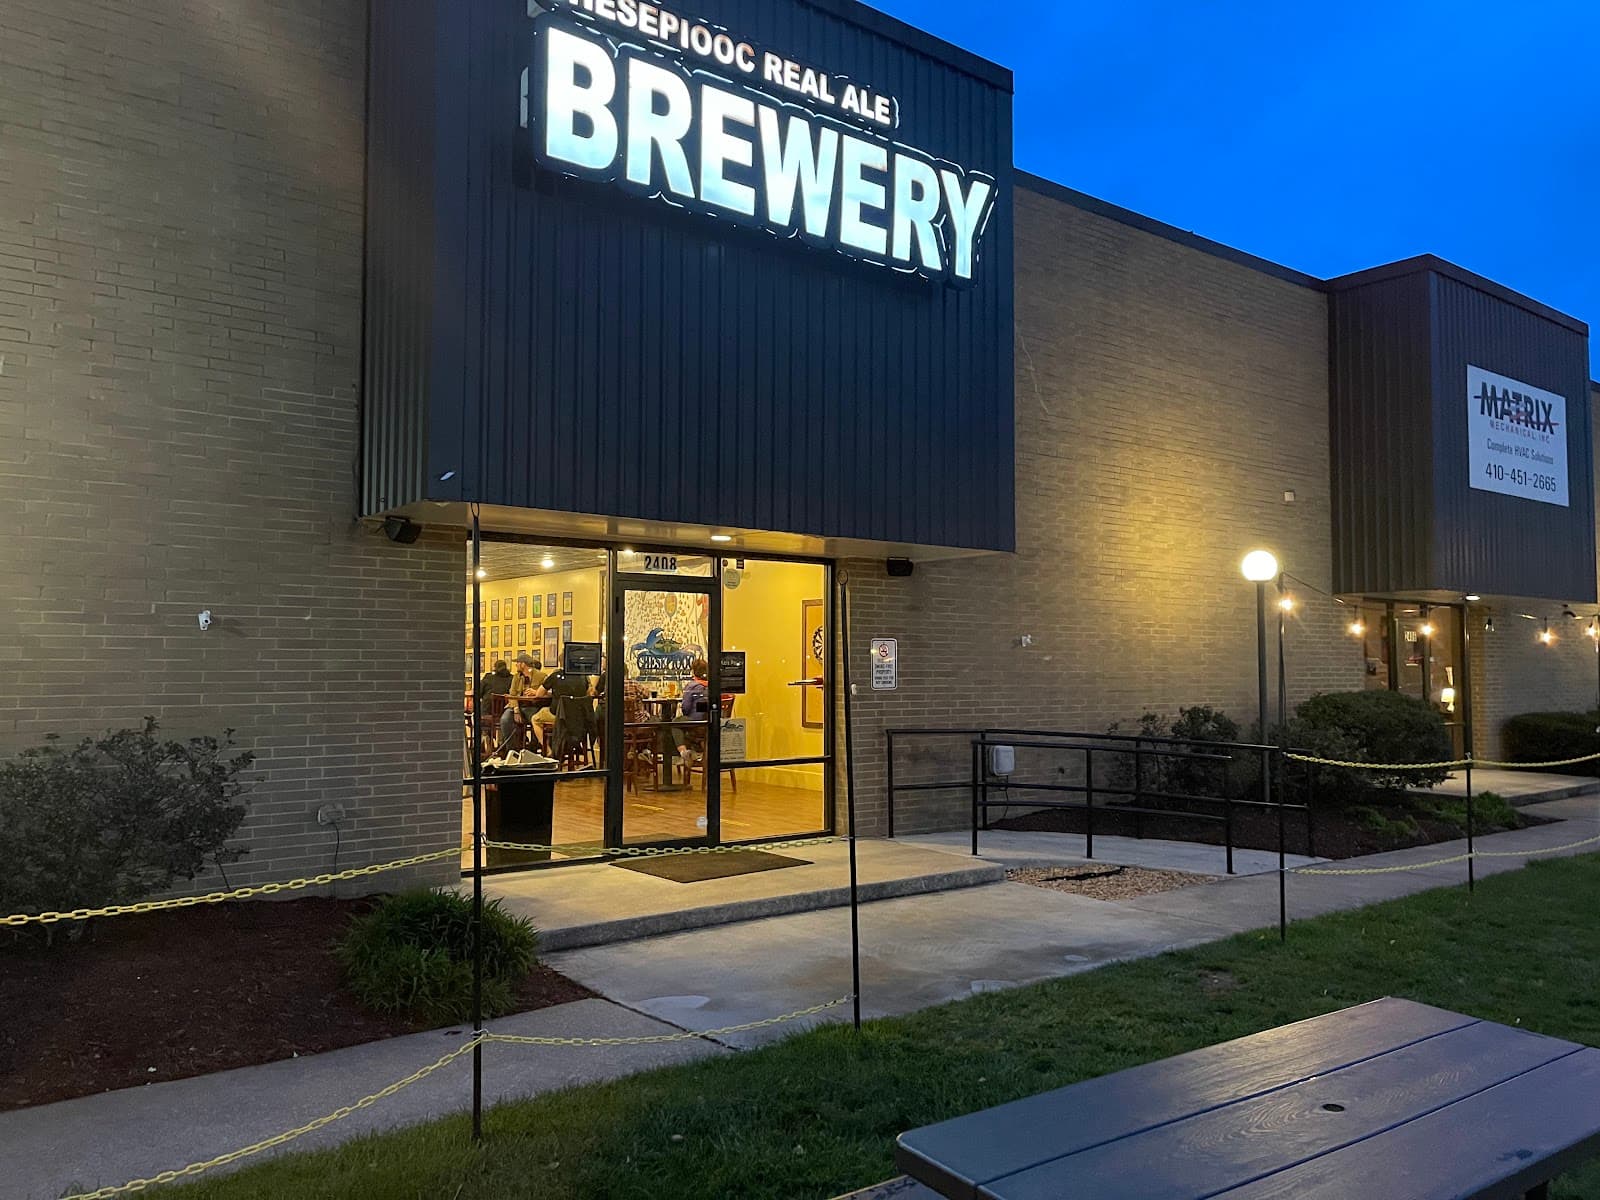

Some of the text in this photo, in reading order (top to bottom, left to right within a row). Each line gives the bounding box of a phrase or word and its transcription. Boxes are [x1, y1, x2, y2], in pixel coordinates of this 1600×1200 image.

[568, 0, 891, 125] ESEPIOOC REAL ALE
[546, 26, 990, 280] BREWERY
[1480, 381, 1554, 435] MATRIX
[1515, 445, 1530, 459] HVAC
[1485, 462, 1556, 492] 410-451-2665
[644, 555, 677, 571] 2408
